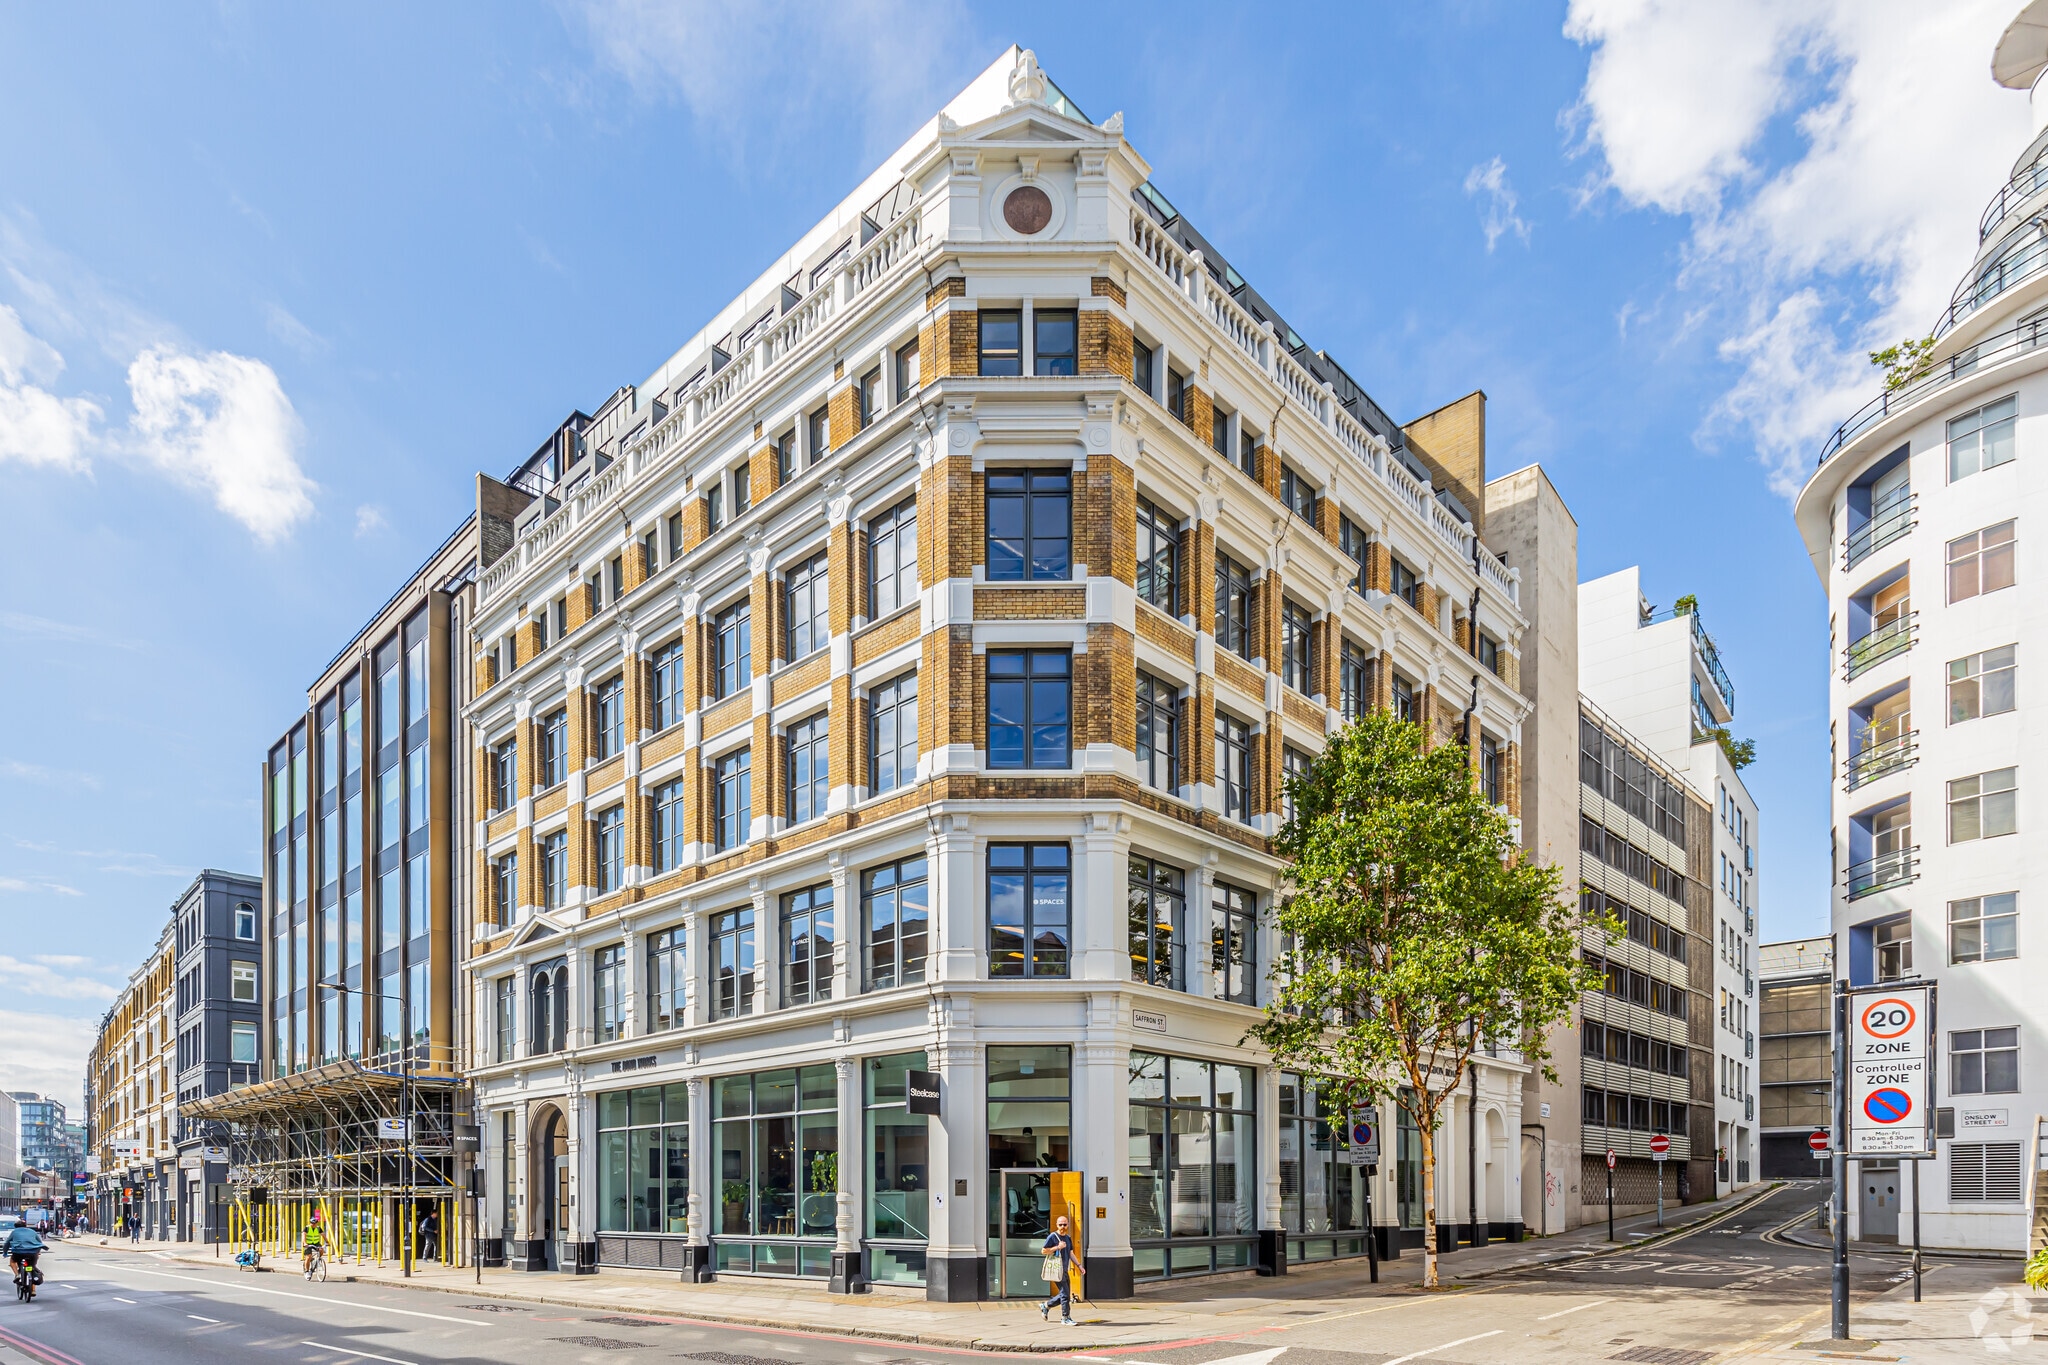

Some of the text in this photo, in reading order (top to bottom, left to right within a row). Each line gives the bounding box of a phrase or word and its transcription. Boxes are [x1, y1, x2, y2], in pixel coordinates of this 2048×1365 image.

[1135, 1014, 1157, 1024] SAFFRON
[1870, 1010, 1906, 1027] 20
[1866, 1042, 1911, 1054] ZONE
[1855, 1062, 1922, 1074] Controlled
[1866, 1073, 1910, 1085] ZONE
[910, 1087, 940, 1099] Steelcase
